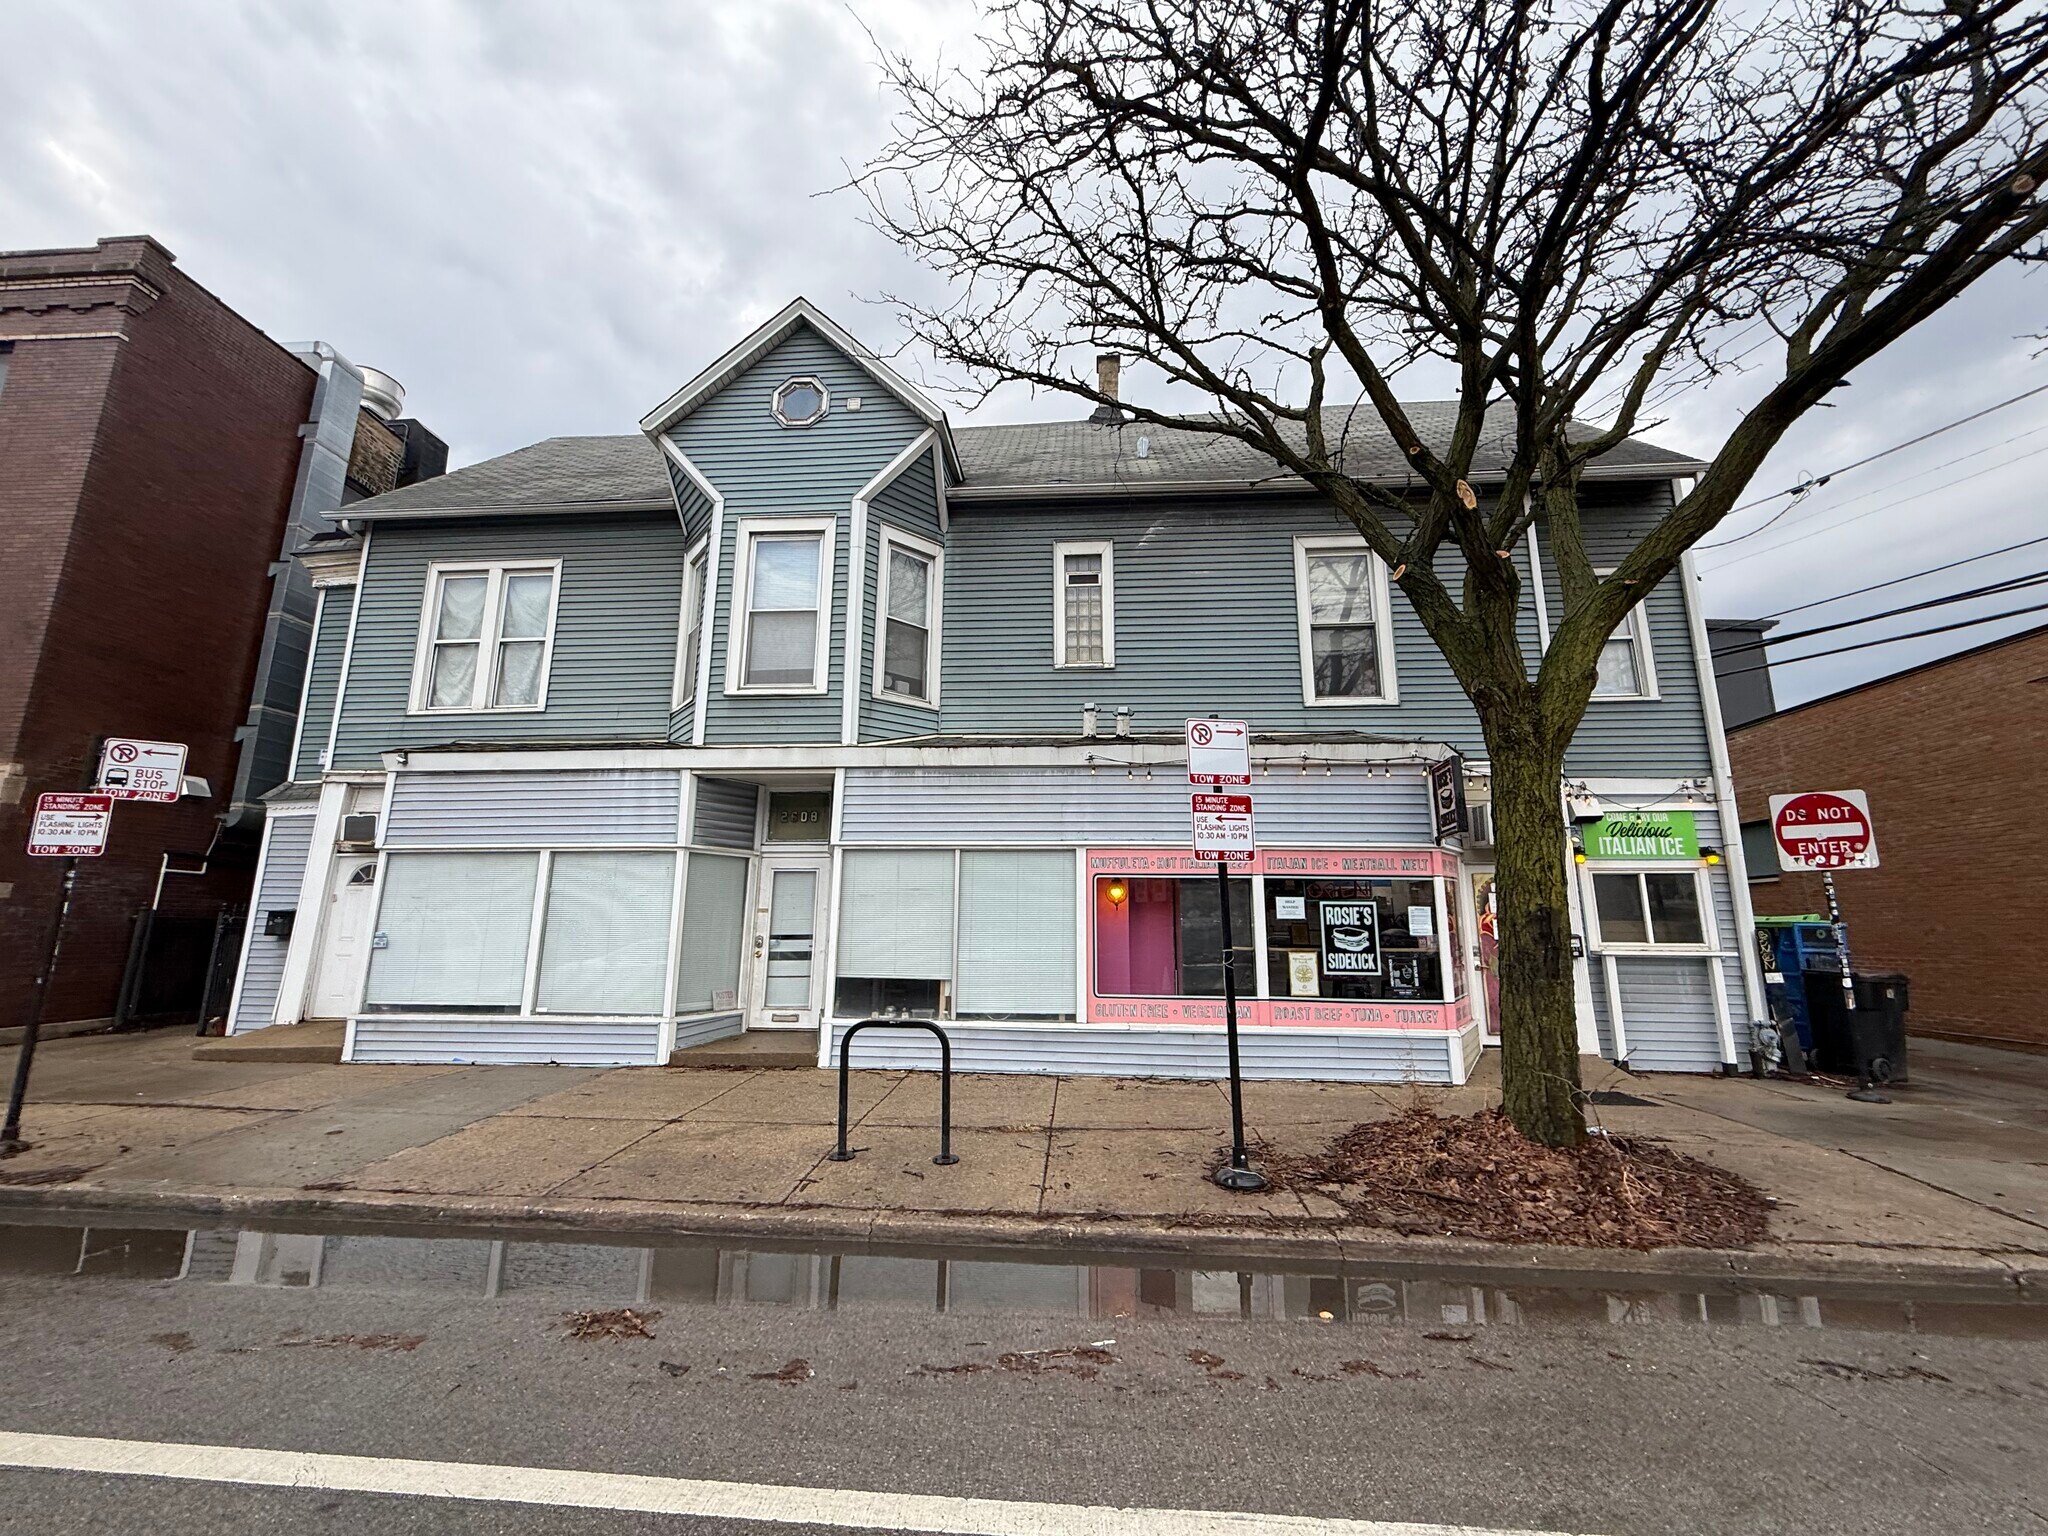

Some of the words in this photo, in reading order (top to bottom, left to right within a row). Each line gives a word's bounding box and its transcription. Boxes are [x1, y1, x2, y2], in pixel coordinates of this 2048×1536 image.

[135, 769, 163, 779] BUS
[1193, 775, 1214, 783] TOW
[1219, 775, 1246, 784] ZONE
[133, 779, 168, 789] STOP
[101, 789, 129, 797] TOW
[135, 791, 170, 800] ZONE
[781, 811, 818, 823] 2608
[1606, 812, 1628, 821] COME
[1629, 813, 1635, 821] &
[1637, 812, 1651, 821] RY
[1652, 812, 1669, 822] OUR
[1817, 806, 1851, 820] NOT
[1606, 821, 1672, 837] Delicious
[65, 846, 96, 854] ZONE
[1598, 836, 1658, 855] ITALIAN
[1660, 837, 1686, 855] ICE
[1798, 841, 1851, 855] ENTER
[1198, 851, 1218, 859] TOW
[1224, 852, 1250, 860] ZONE
[1091, 857, 1149, 869] MUFFULETA
[1157, 857, 1177, 869] HOT
[1267, 857, 1307, 869] ITALIAN
[1311, 857, 1329, 869] ICE
[1342, 858, 1397, 870] MEATBALL
[1401, 858, 1429, 871] MELT
[1325, 906, 1372, 926] ROSIE'S
[1328, 953, 1376, 970] SIDEKICK
[1095, 1004, 1137, 1017] GLUTEN
[1140, 1004, 1168, 1018] FREE
[1182, 1005, 1251, 1019] VEGETAAN
[1274, 1006, 1311, 1020] ROAST
[1314, 1007, 1343, 1021] BEEF
[1351, 1008, 1382, 1022] TUNA
[1393, 1009, 1439, 1023] TURKEY
